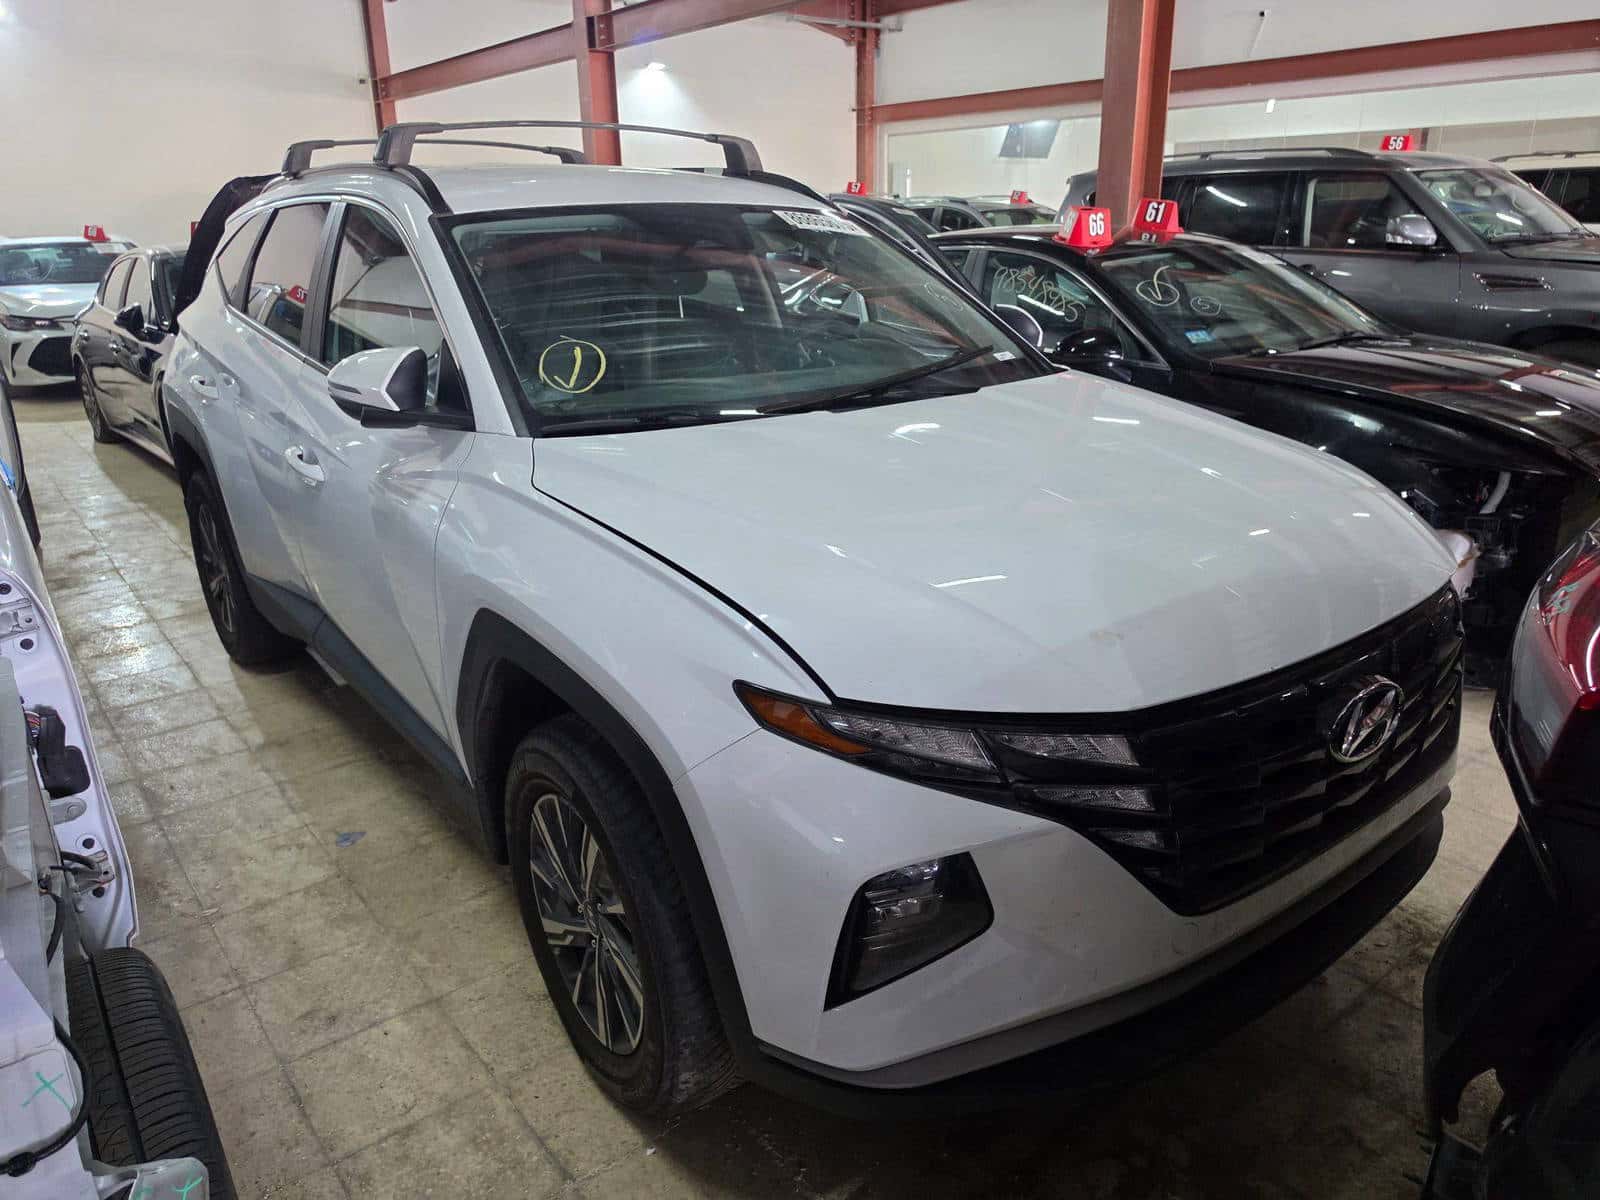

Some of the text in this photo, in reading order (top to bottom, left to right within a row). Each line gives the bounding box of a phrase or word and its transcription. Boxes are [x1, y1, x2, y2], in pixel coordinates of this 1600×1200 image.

[1388, 136, 1404, 150] 56
[1145, 201, 1166, 223] 61
[1088, 212, 1105, 236] 66
